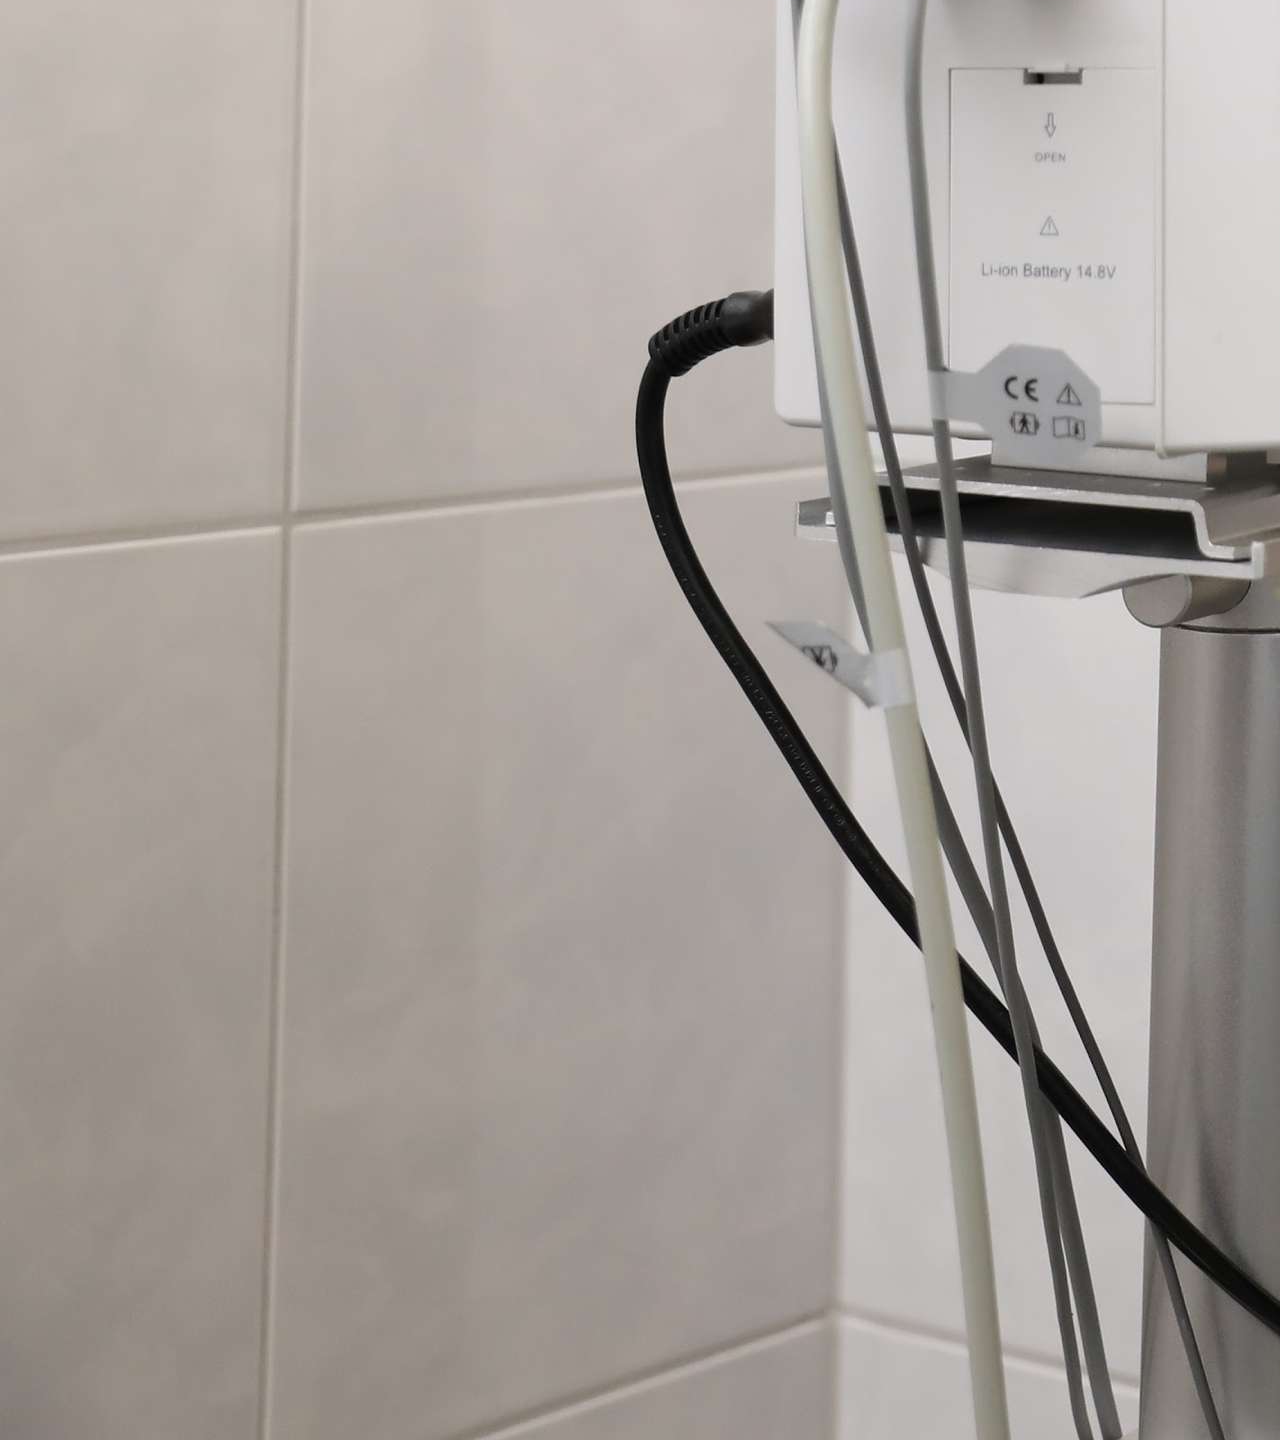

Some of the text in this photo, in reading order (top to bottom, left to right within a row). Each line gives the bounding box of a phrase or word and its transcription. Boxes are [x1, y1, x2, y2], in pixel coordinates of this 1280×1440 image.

[1034, 152, 1066, 163] OPEN
[981, 262, 1117, 281] Li-ion Battery 14.8V
